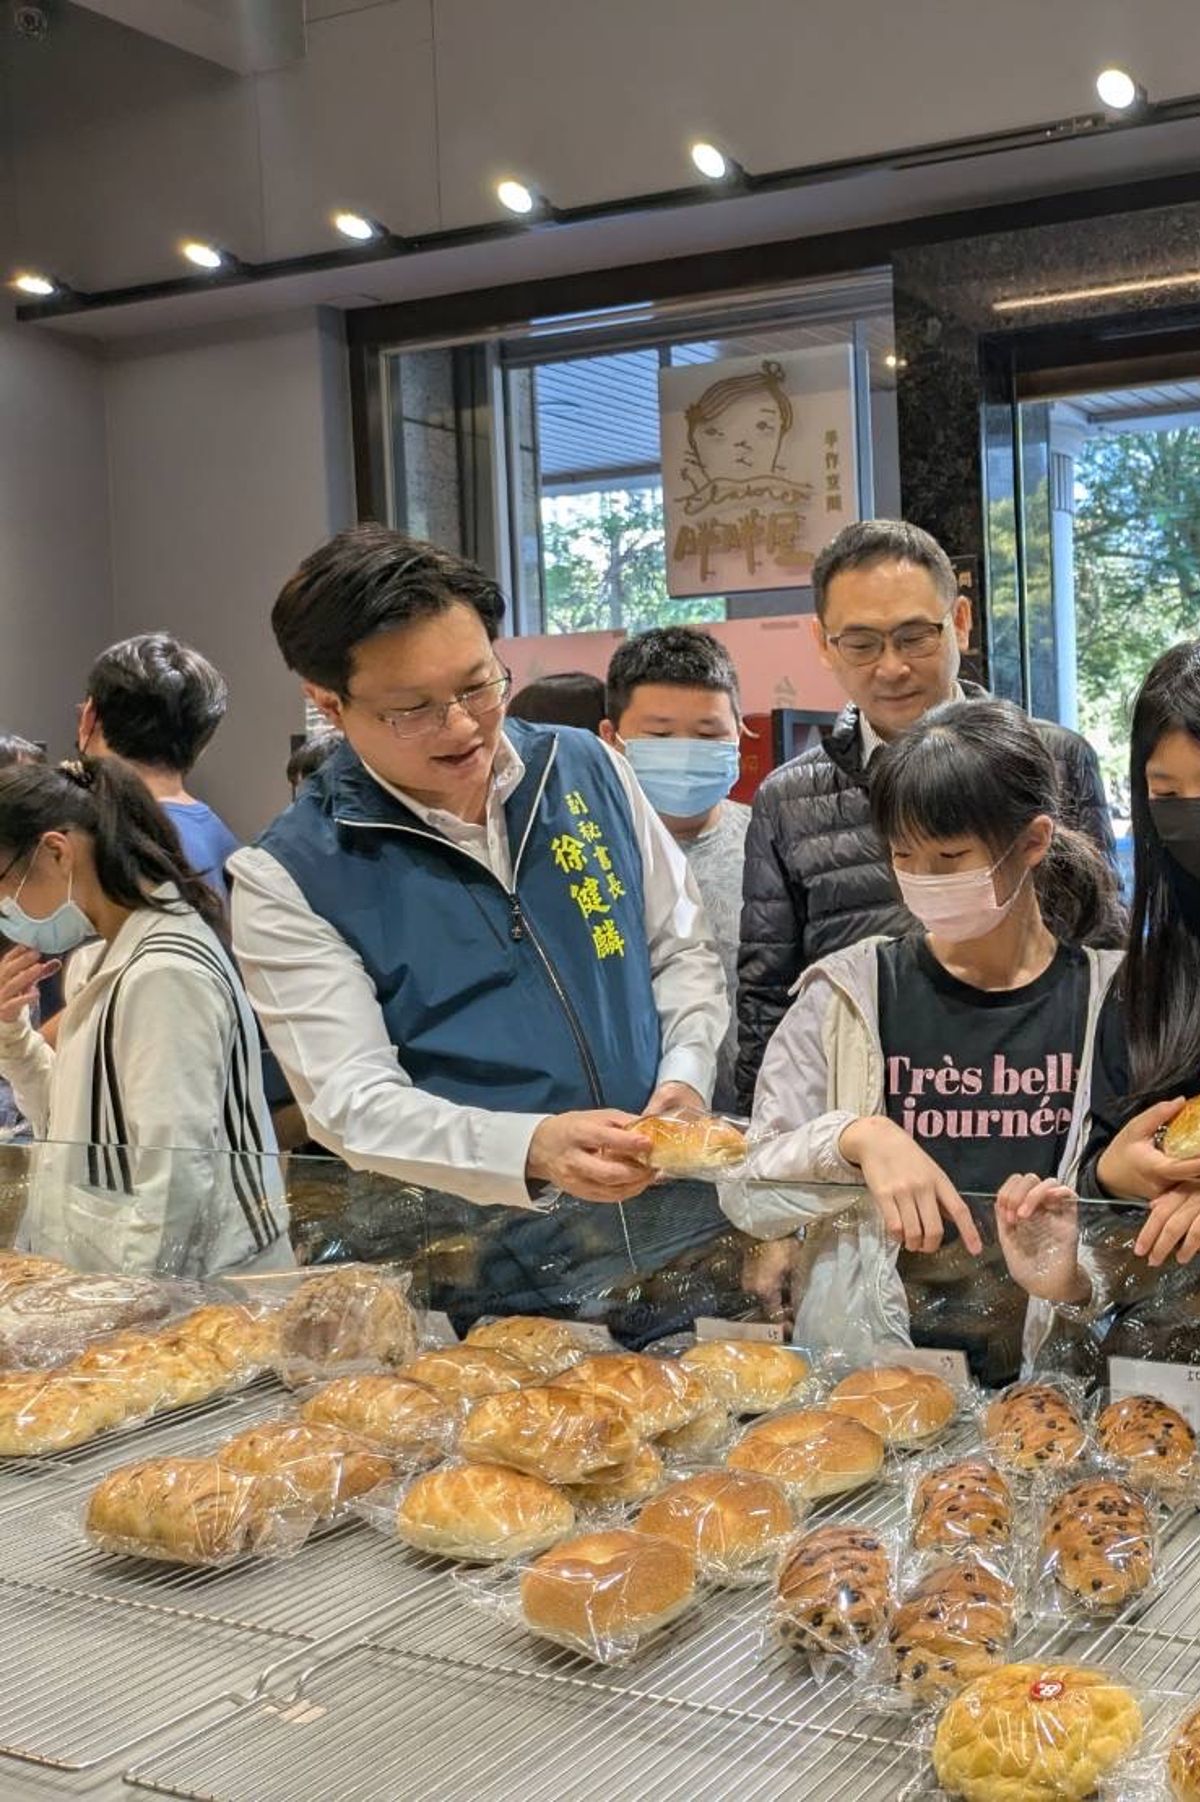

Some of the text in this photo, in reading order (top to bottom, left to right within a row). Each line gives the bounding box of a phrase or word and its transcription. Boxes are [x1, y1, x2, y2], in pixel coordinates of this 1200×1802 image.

[887, 1053, 1080, 1095] Très bell
[901, 1096, 1072, 1138] journée
